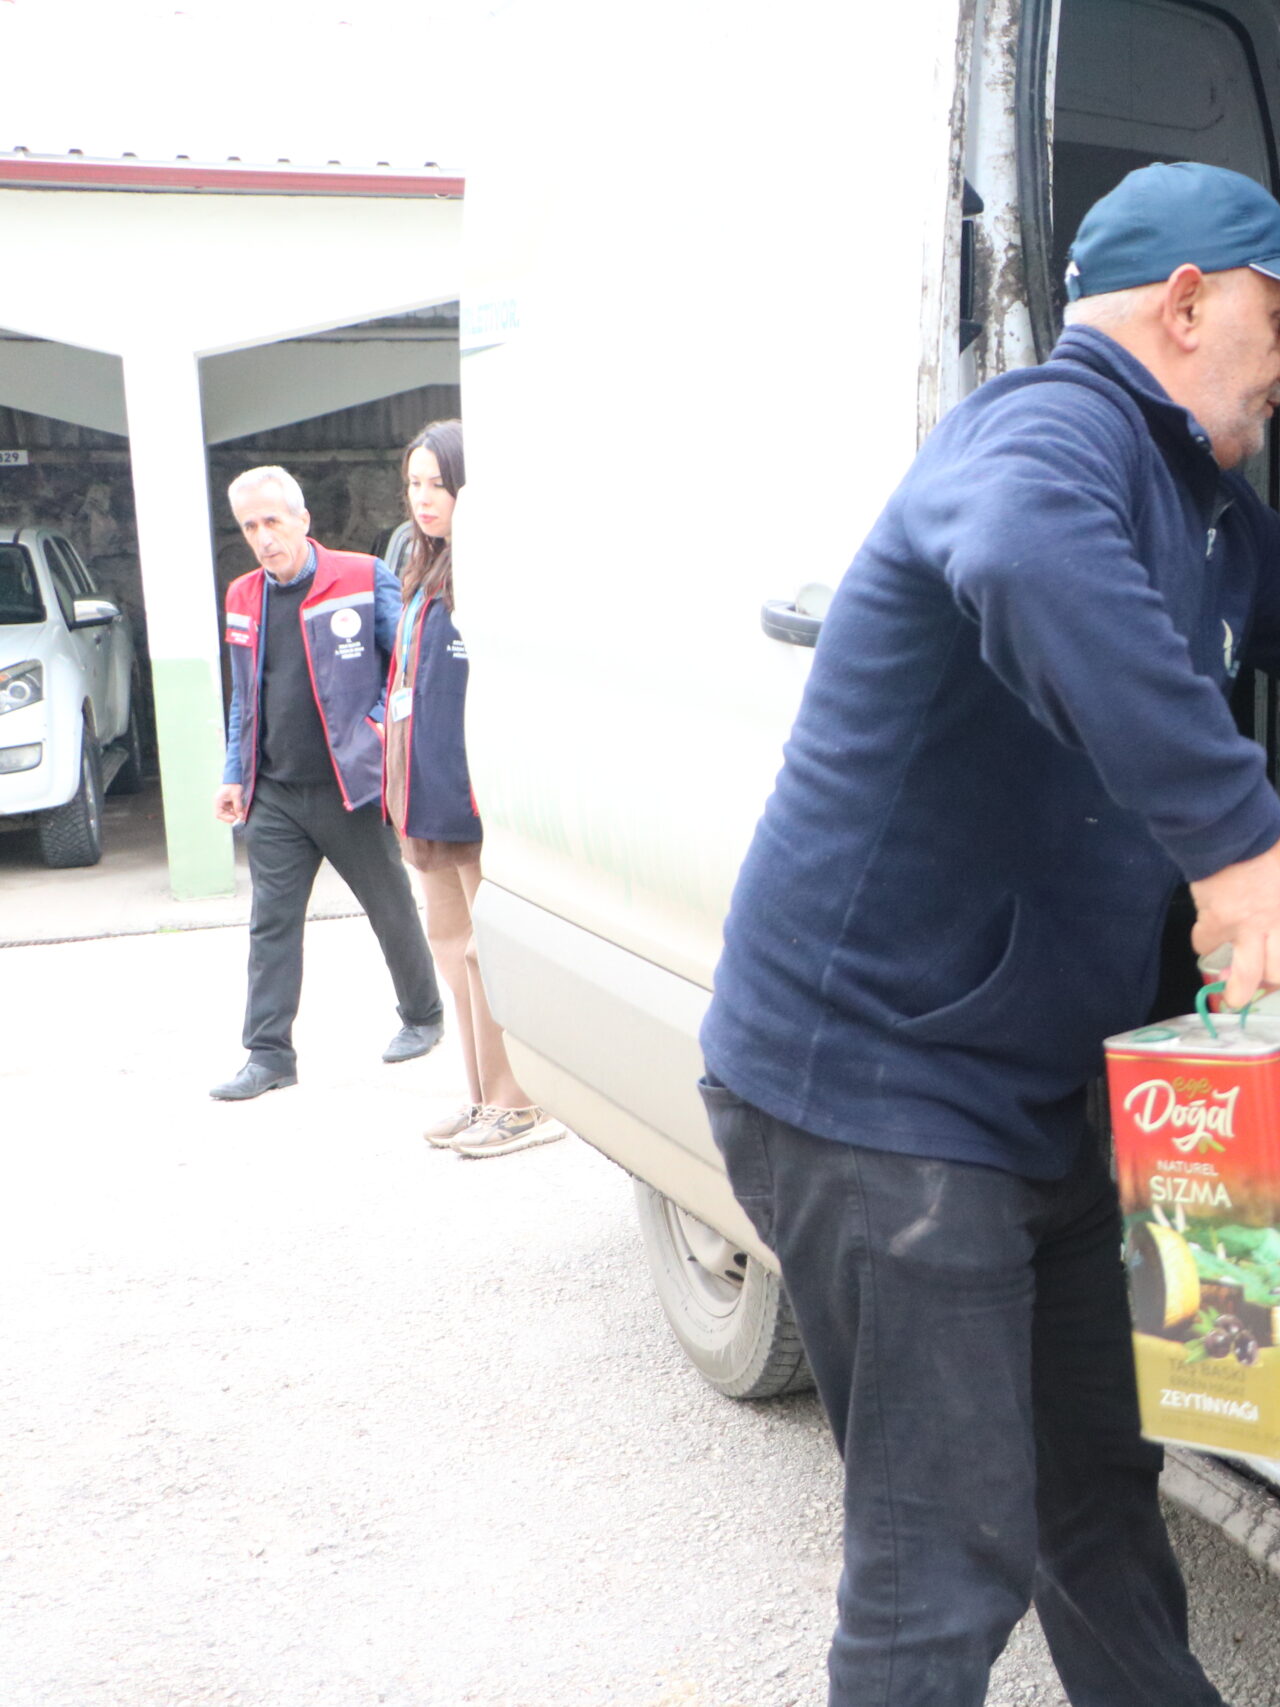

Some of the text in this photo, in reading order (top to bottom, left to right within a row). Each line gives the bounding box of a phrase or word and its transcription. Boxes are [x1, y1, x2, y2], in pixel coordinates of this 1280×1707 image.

[1123, 1079, 1240, 1153] Doğal
[1157, 1160, 1219, 1176] NATUREL
[1149, 1175, 1232, 1208] SIZMA
